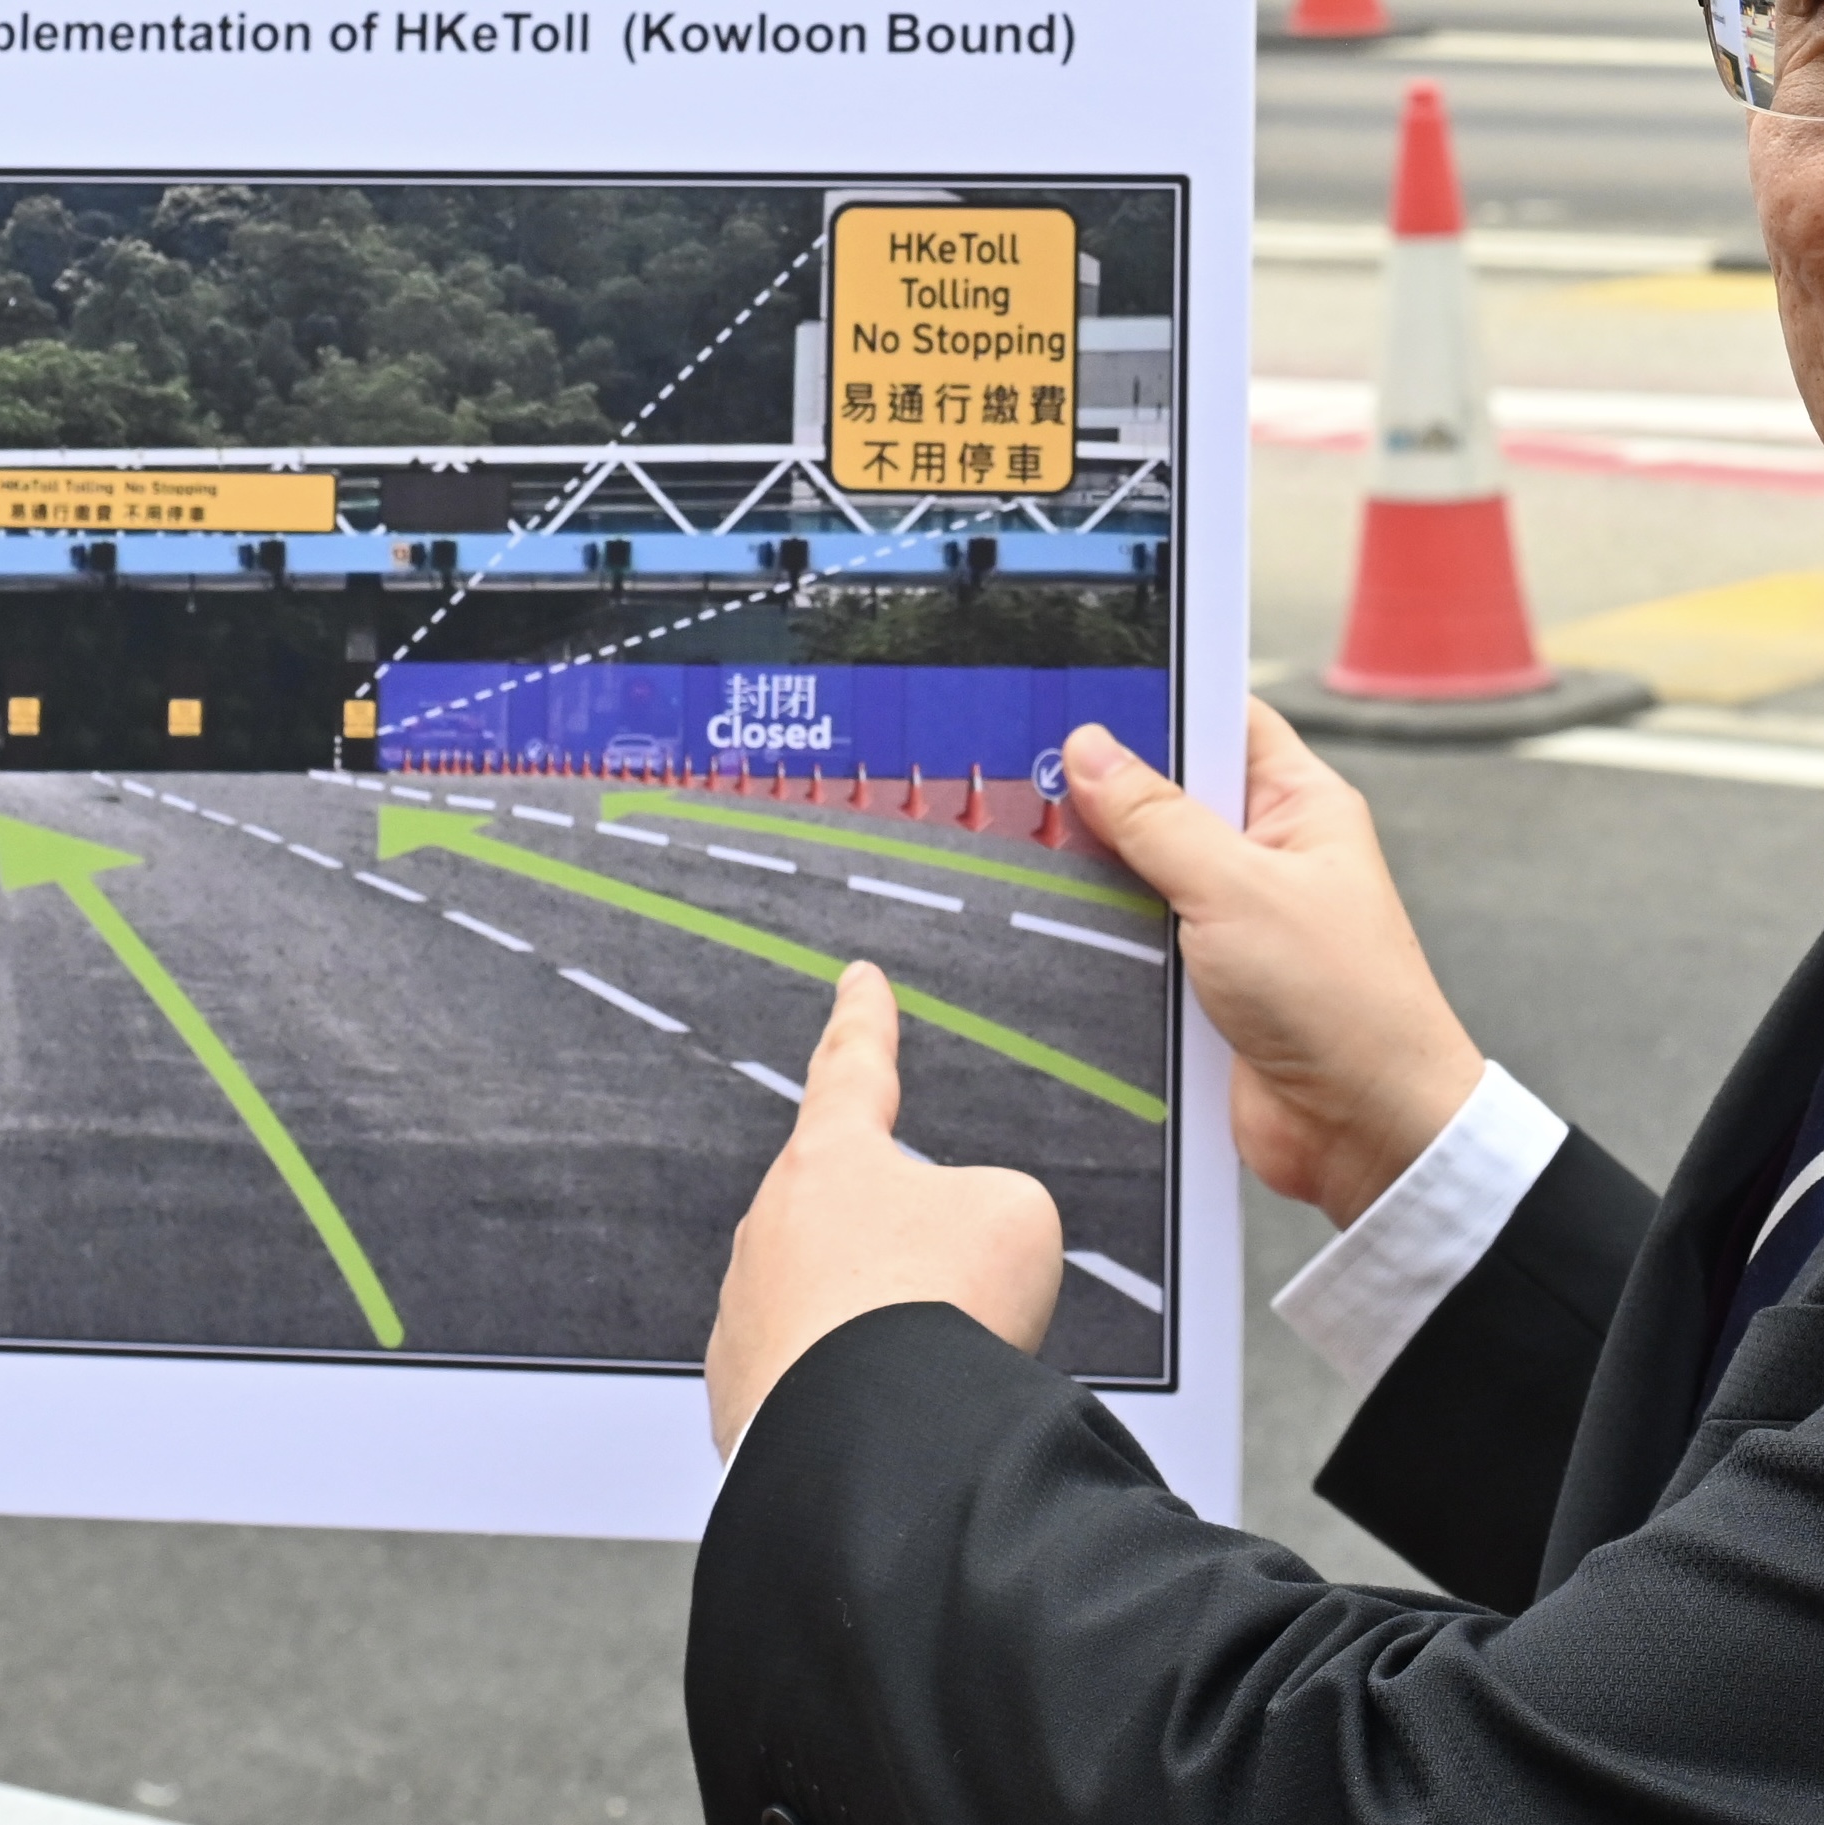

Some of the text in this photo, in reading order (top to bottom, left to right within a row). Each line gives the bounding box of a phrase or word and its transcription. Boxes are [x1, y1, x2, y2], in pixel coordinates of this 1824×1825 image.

[329, 11, 380, 53] of
[395, 12, 590, 53] HKeToll
[623, 12, 866, 64] (Kowloon
[887, 12, 1075, 66] Bound)
[889, 231, 1020, 265] HKeToll
[899, 277, 1011, 316] Tolling
[852, 322, 1067, 362] No Stopping
[841, 382, 1067, 426] 易通行繳費
[862, 440, 1044, 485] 不用停車
[724, 673, 816, 721] 封閉
[706, 711, 833, 751] Closed
